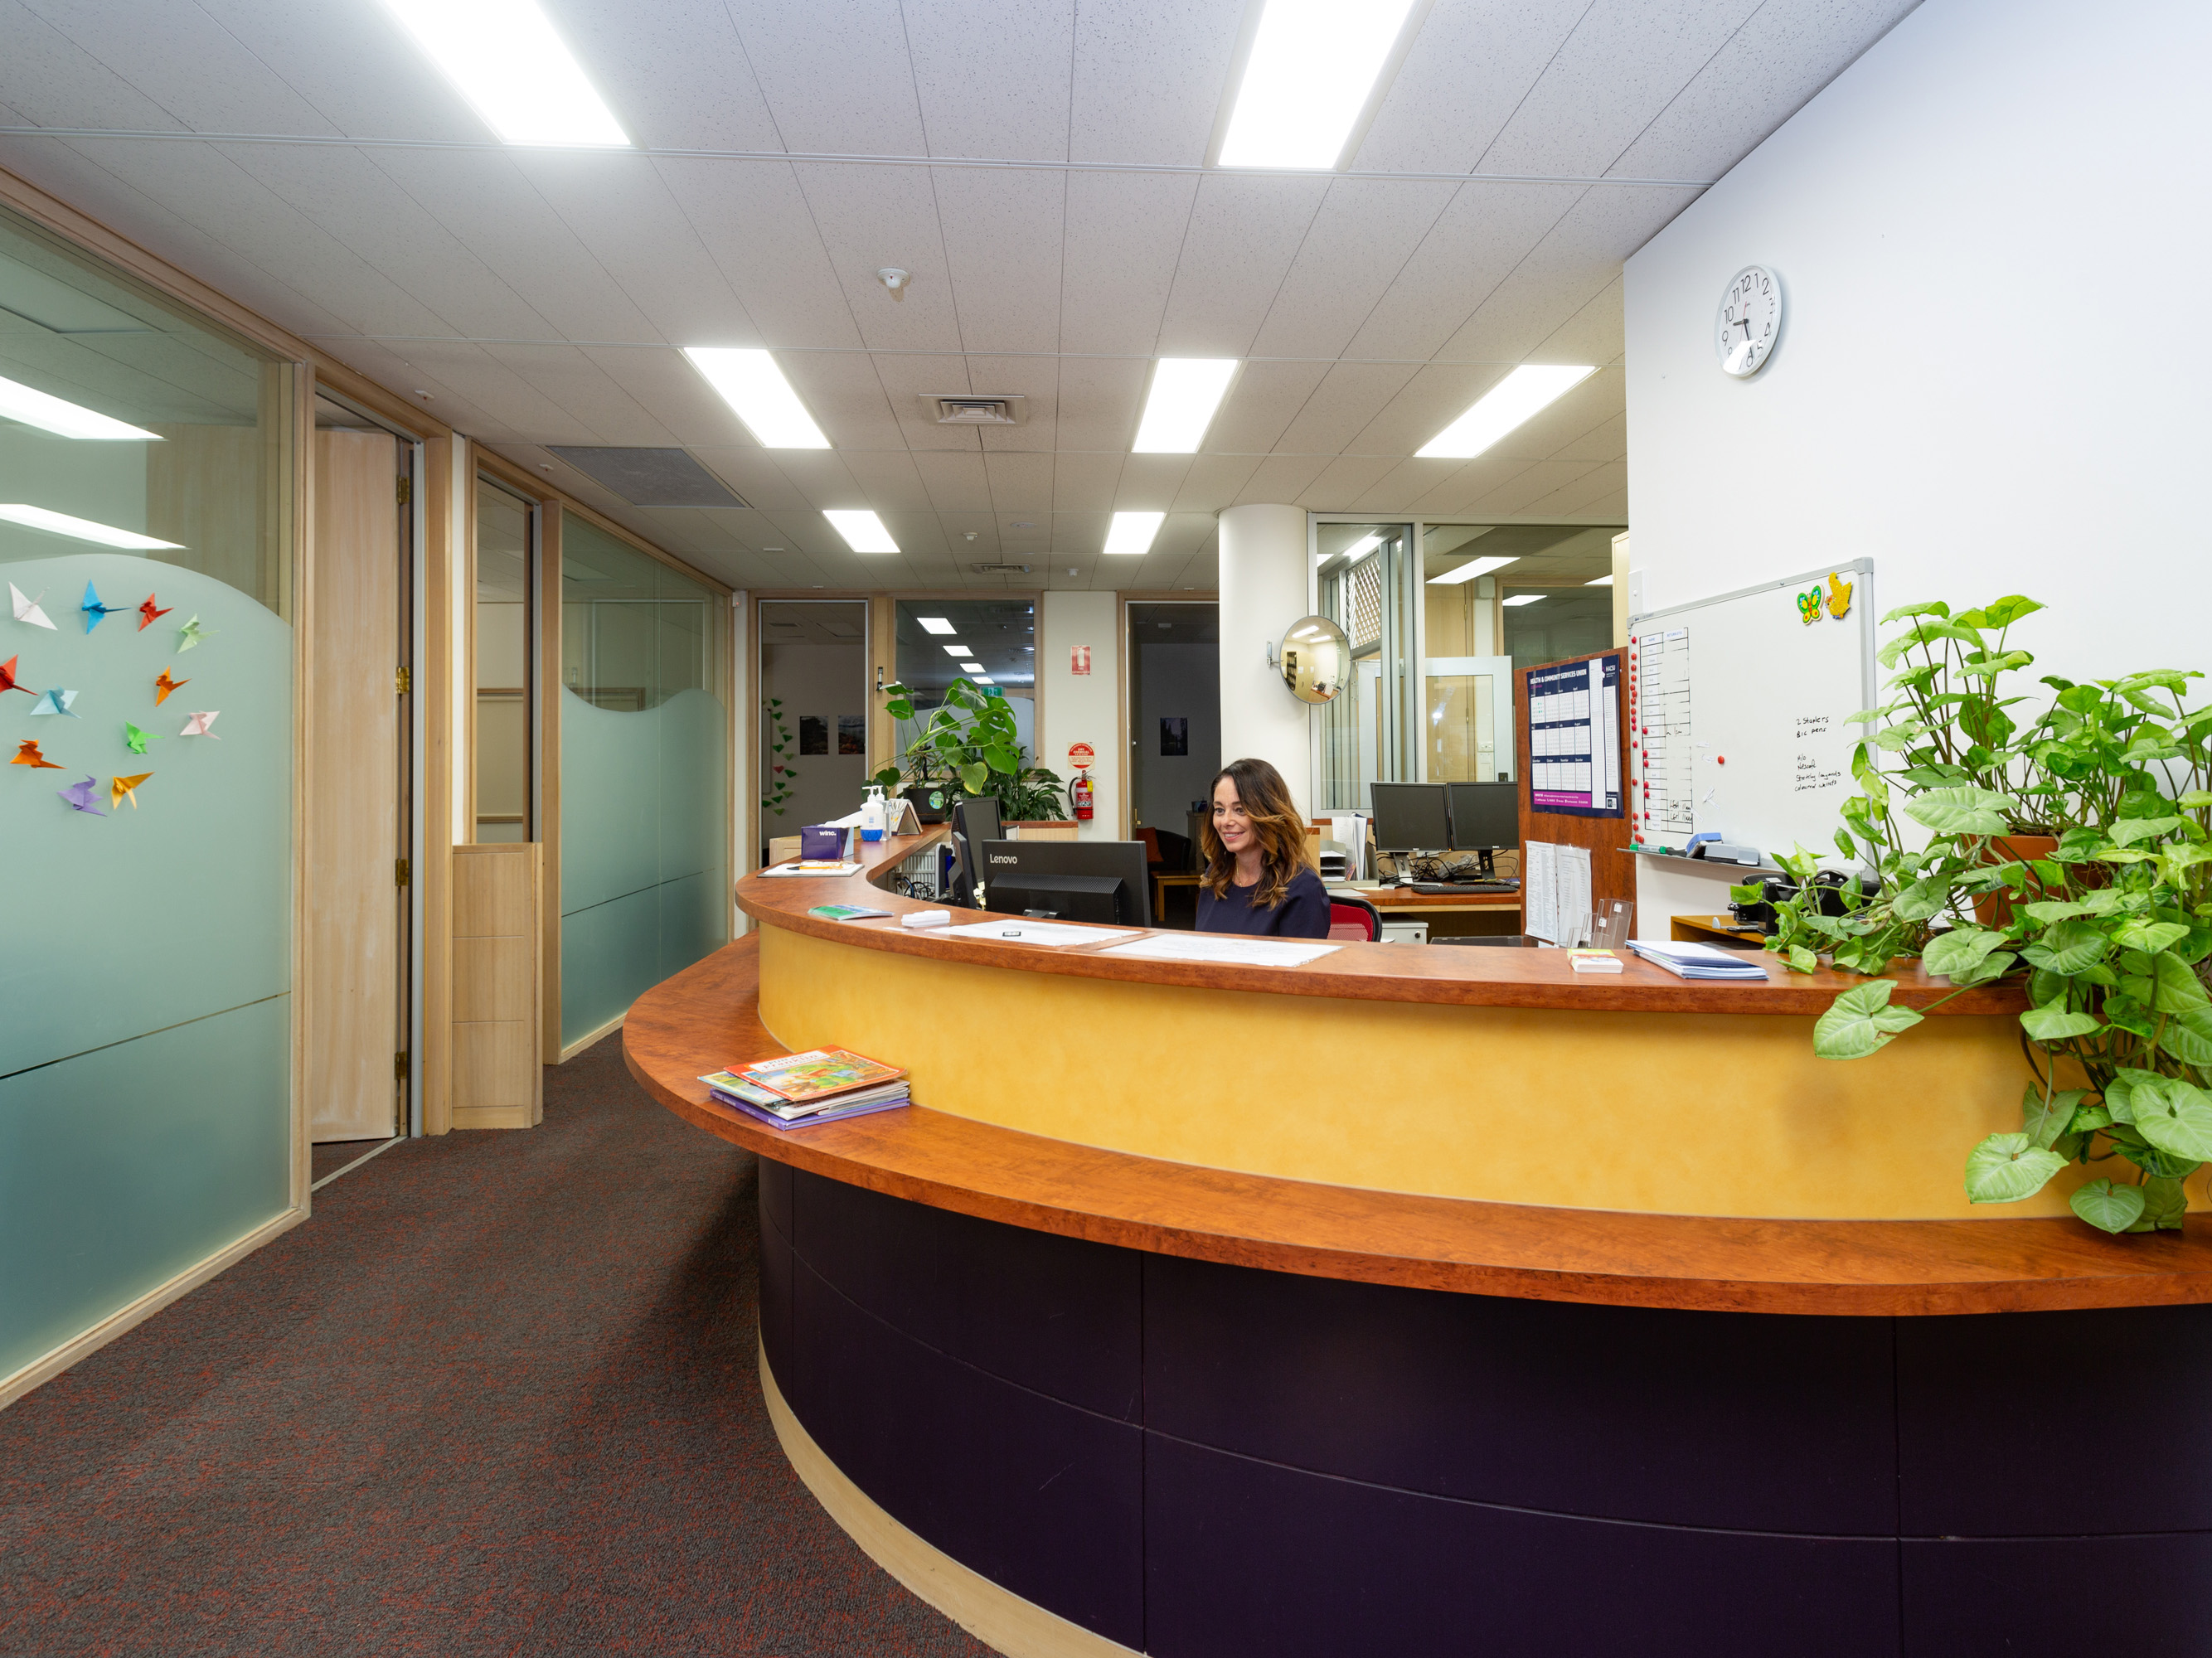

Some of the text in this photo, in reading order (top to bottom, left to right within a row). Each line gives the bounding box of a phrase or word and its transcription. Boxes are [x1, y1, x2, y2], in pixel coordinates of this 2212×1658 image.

[1740, 274, 1752, 294] 12
[1754, 273, 1759, 288] 1
[1761, 277, 1769, 296] 2
[1732, 287, 1740, 304] 11
[1724, 305, 1734, 324] 10
[1721, 330, 1729, 347] 9
[989, 853, 1018, 865] Lenovo
